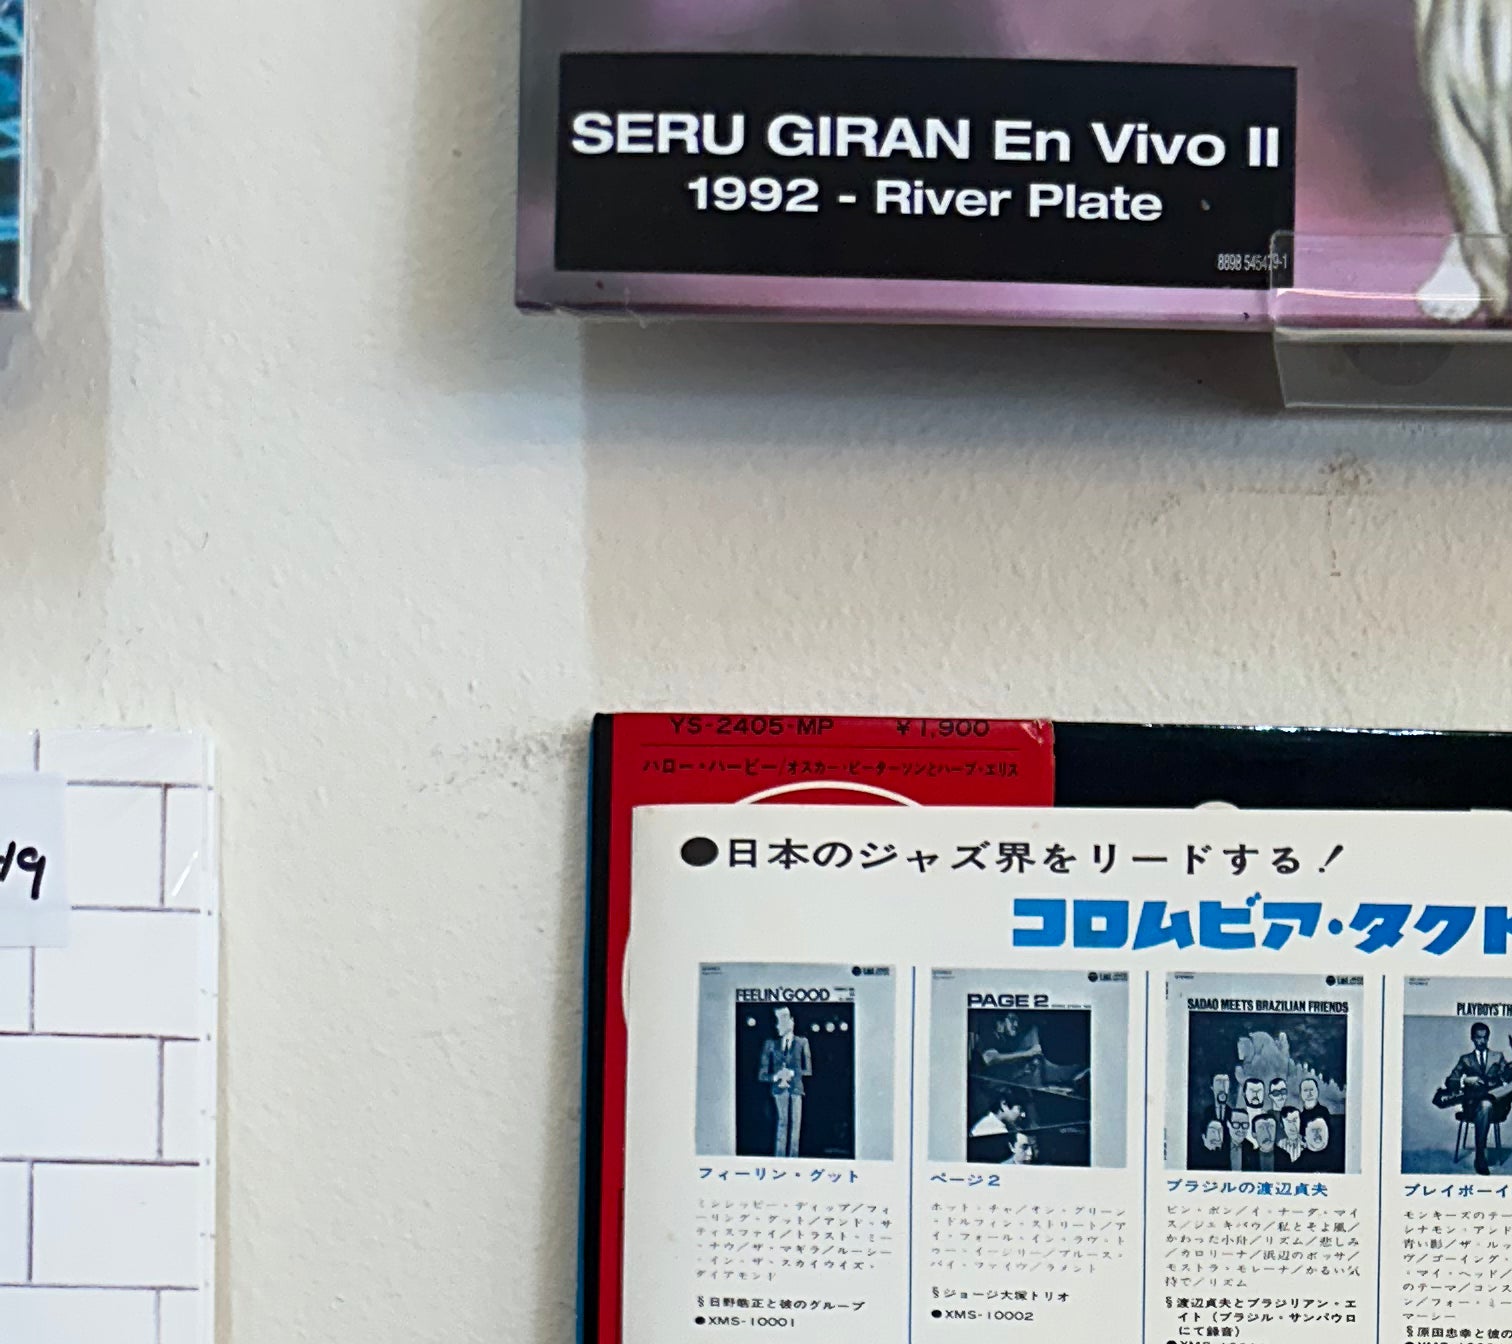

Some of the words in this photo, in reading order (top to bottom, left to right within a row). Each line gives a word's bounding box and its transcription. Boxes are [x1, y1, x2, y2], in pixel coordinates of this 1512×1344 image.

[571, 111, 747, 158] SERU
[765, 114, 972, 162] GIRAN
[992, 118, 1071, 165] En
[1090, 121, 1228, 169] Vivo
[1248, 126, 1281, 169] II
[686, 175, 822, 214] 1992
[874, 178, 1012, 218] River
[1027, 181, 1164, 223] Plate
[669, 717, 835, 738] YS-2405-MP
[966, 992, 1030, 1008] PAGE
[1033, 993, 1050, 1009] 2
[1186, 997, 1220, 1011] SADAO
[1220, 998, 1254, 1012] MEETS
[1255, 999, 1307, 1013] BRAZILIAN
[1307, 1000, 1350, 1014] FRIENDS
[708, 1315, 797, 1329] XMS-10001
[944, 1308, 1035, 1322] XMS-10002
